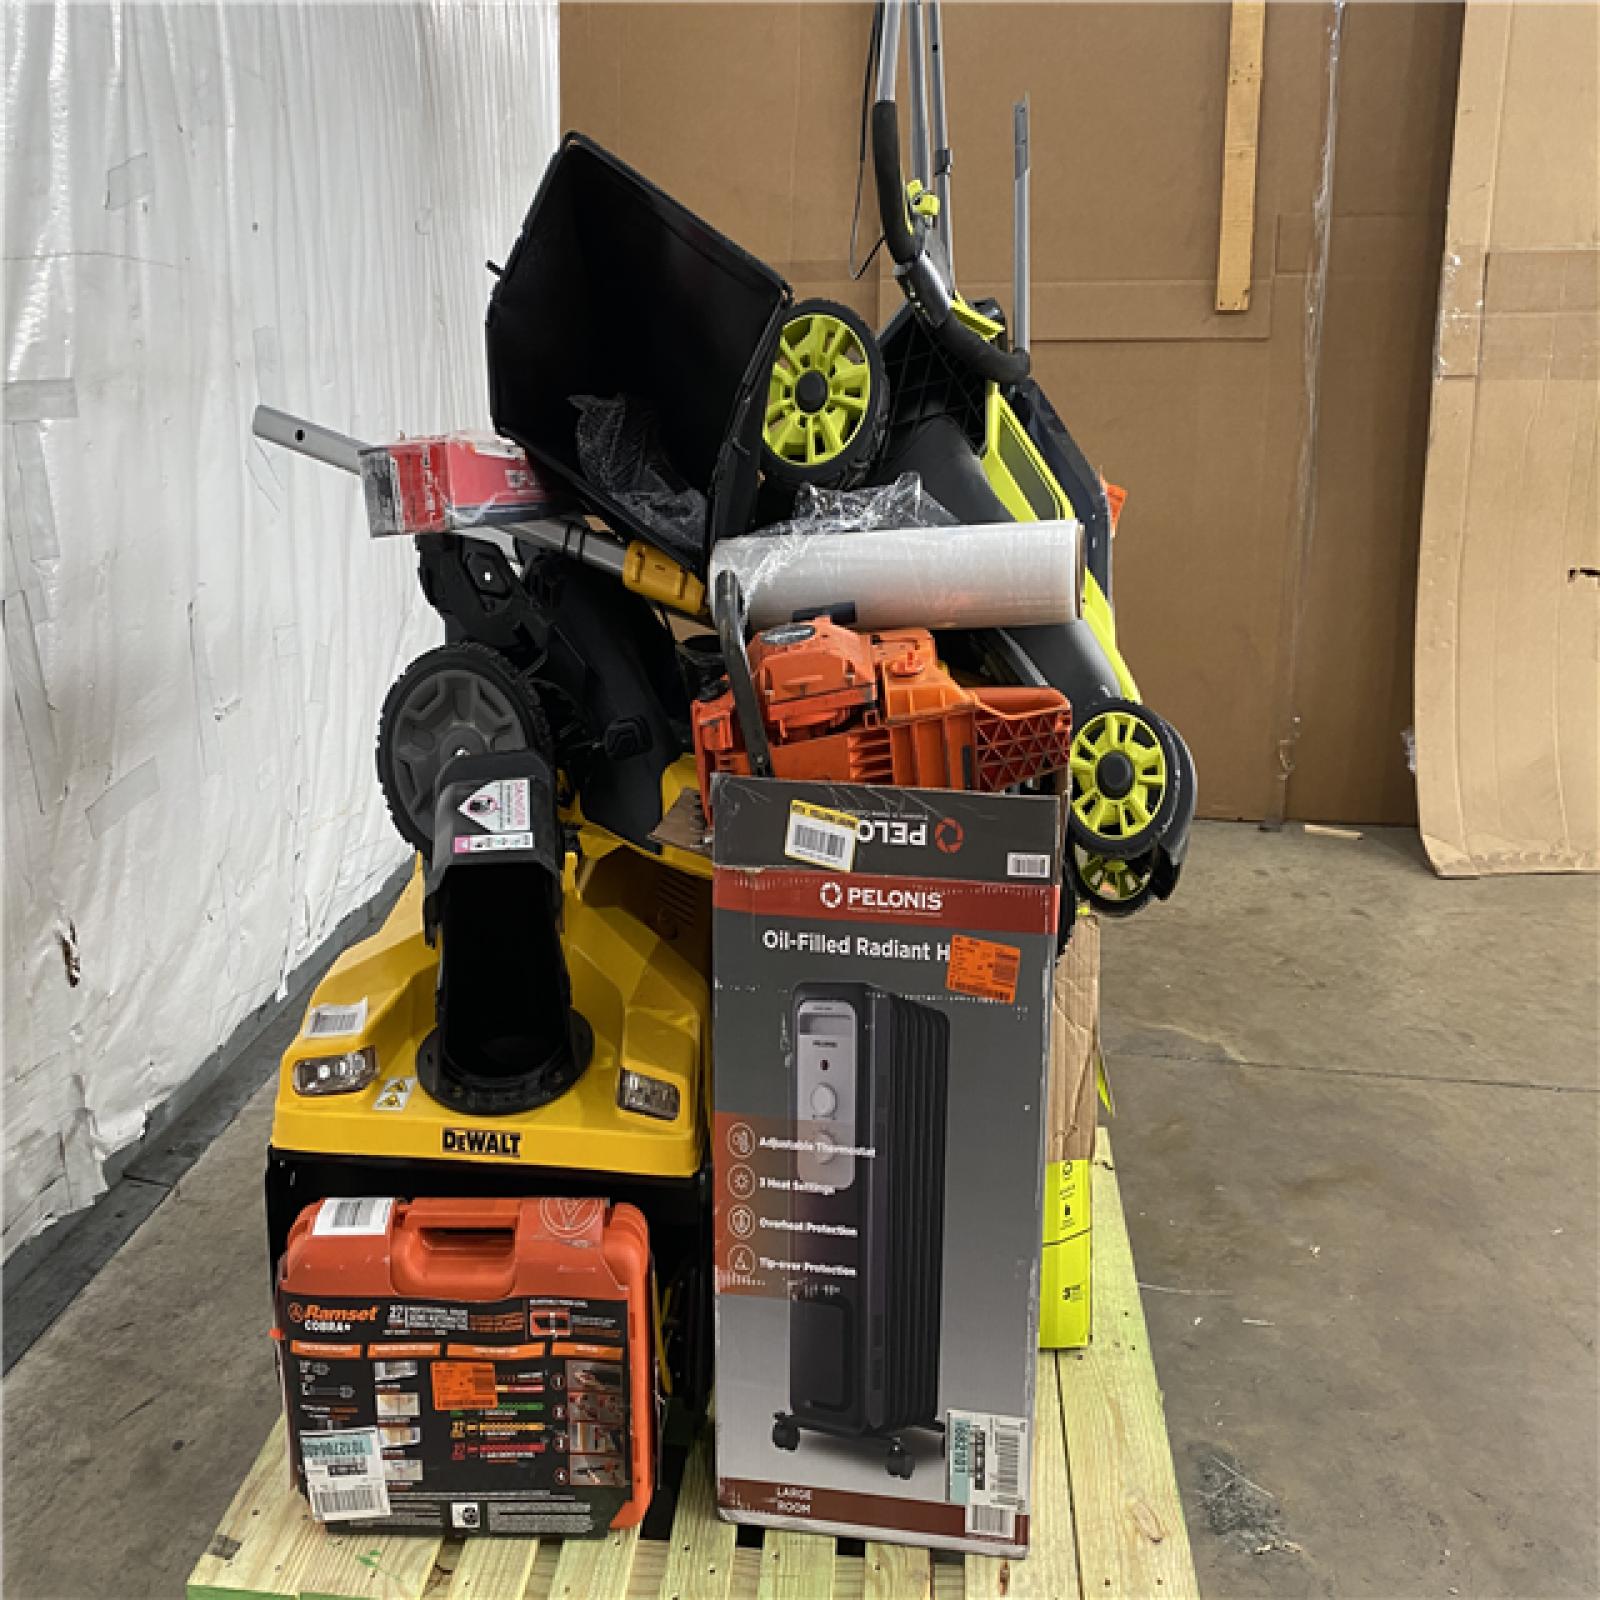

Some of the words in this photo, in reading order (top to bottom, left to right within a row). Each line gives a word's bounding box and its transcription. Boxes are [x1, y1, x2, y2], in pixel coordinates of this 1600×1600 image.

[858, 819, 928, 846] PELO
[847, 887, 944, 911] PELONIS
[762, 929, 850, 956] Oil-Filled
[856, 936, 931, 961] Radiant
[936, 944, 951, 962] H
[806, 1222, 859, 1237] Protection
[804, 1262, 858, 1278] Protection
[303, 1304, 379, 1321] Ramset
[776, 1486, 813, 1500] LARGE
[777, 1501, 811, 1516] ROOM
